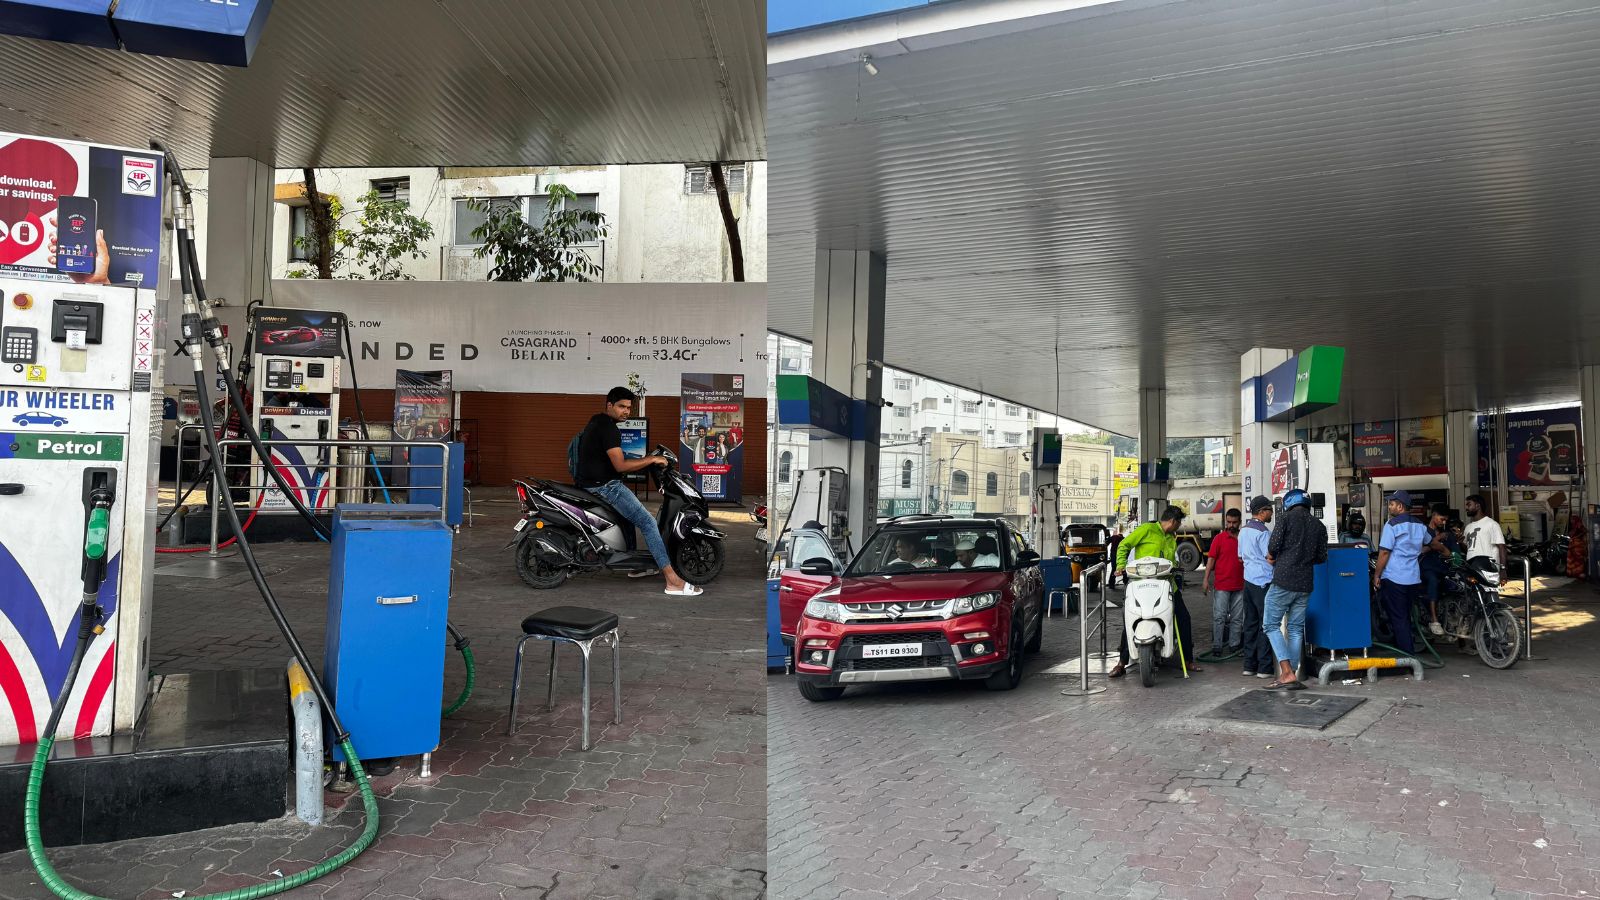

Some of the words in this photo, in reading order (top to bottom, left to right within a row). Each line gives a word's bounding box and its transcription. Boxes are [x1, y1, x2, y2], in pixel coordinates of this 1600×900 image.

[133, 172, 146, 180] HP
[0, 175, 57, 190] download.
[12, 189, 57, 202] savings.
[359, 320, 381, 328] now
[500, 337, 577, 348] CASAGRAND
[600, 335, 631, 344] 4000+
[634, 336, 649, 345] sft.
[652, 336, 658, 345] 5
[660, 336, 679, 345] BHK
[681, 336, 731, 347] Bungalows
[629, 352, 650, 361] from
[26, 391, 115, 411] WHEELER
[1508, 418, 1545, 429] payments
[37, 438, 103, 456] Petrol
[871, 648, 888, 656] TS11
